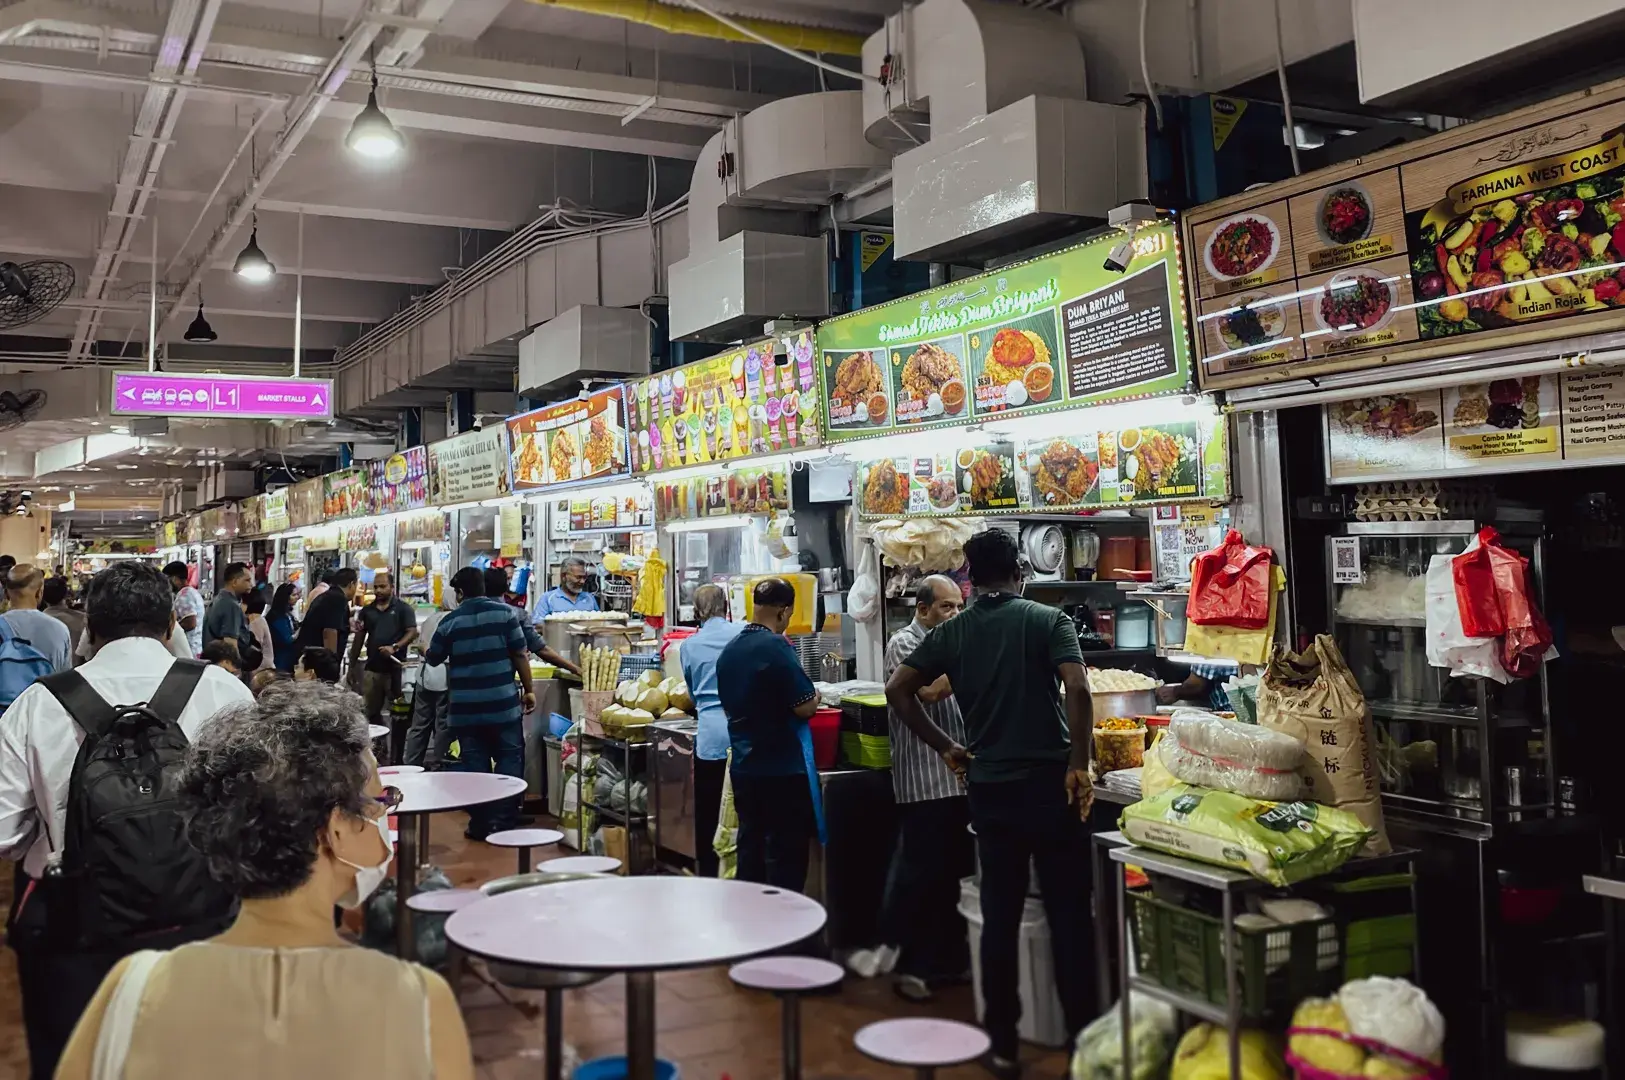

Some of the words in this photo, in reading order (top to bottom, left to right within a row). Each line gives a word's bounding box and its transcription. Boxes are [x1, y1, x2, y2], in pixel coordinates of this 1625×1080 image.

[1462, 174, 1524, 203] FARHANA
[1527, 164, 1566, 184] WEST
[1570, 146, 1619, 173] COAST
[1333, 246, 1354, 256] Goreng
[1356, 238, 1381, 250] Chicken/
[1351, 248, 1378, 259] Rice/Ikan
[1244, 276, 1262, 285] Goreng
[1068, 304, 1088, 320] DUM
[1089, 289, 1125, 314] BRIYANI
[1518, 301, 1552, 315] Indian
[1554, 293, 1587, 309] Rojak
[1377, 332, 1394, 341] Steak
[977, 376, 991, 386] $6.50
[215, 388, 236, 406] L1
[283, 395, 306, 403] STALLS
[1482, 434, 1505, 442] Combo
[1506, 432, 1523, 440] Meal
[1120, 484, 1134, 493] $7.00
[1158, 486, 1176, 496] PRAWN
[1185, 528, 1197, 537] PAY
[1185, 536, 1204, 545] NOW
[1318, 706, 1340, 774] 金链标
[1175, 838, 1190, 849] Rice
